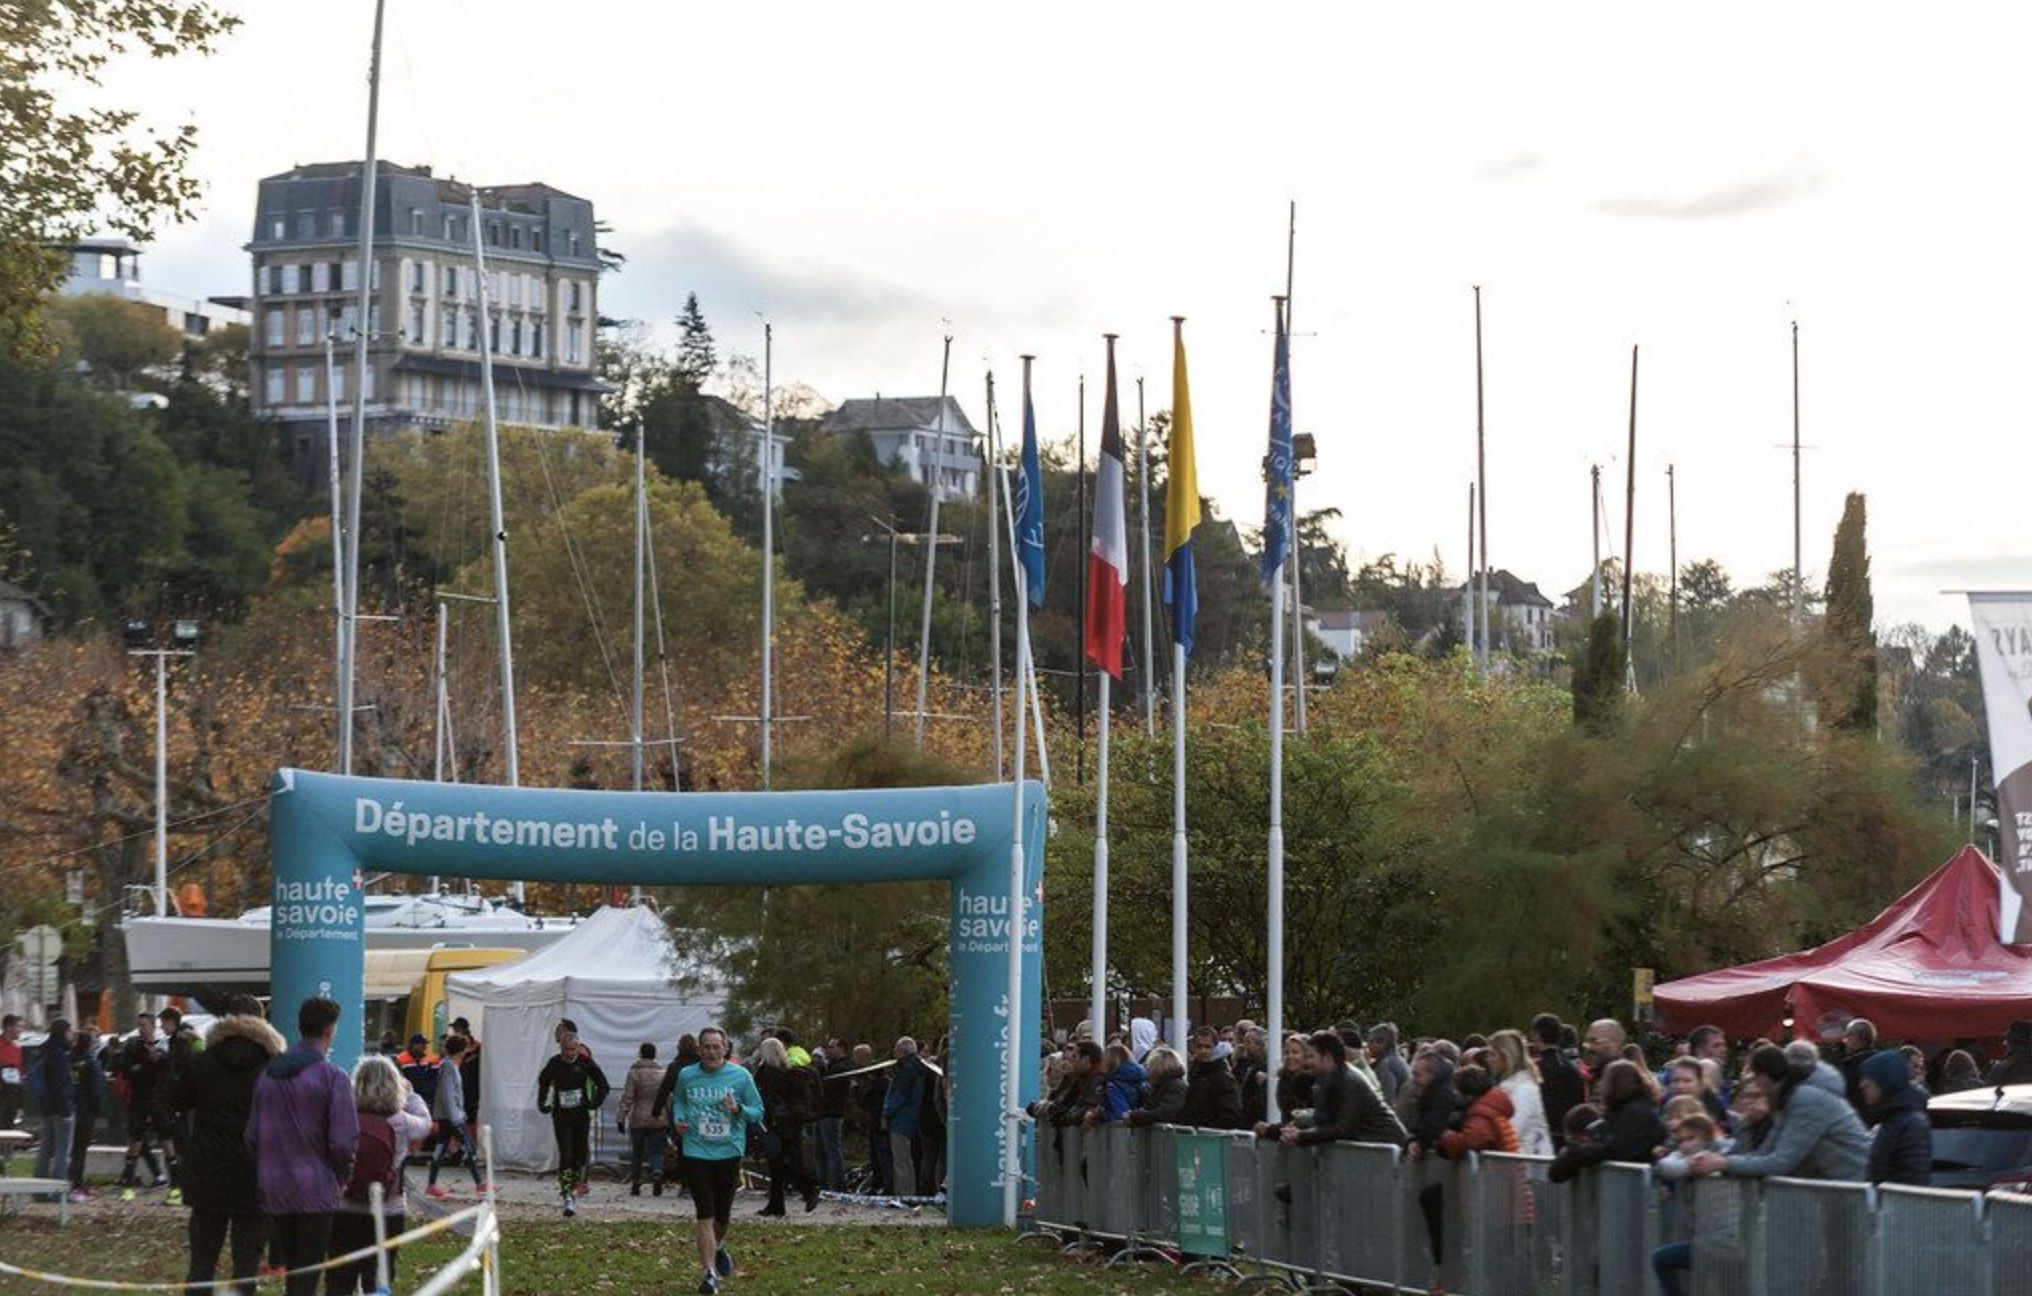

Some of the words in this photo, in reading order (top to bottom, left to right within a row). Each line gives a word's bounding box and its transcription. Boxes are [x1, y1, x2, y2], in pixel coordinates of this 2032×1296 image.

[355, 797, 618, 850] Département
[629, 821, 665, 850] de
[674, 821, 698, 850] la
[708, 810, 976, 851] Haute-Savoie
[276, 875, 349, 901] haute
[959, 887, 1032, 915] haue
[276, 904, 358, 925] savoie
[286, 927, 358, 941] Département
